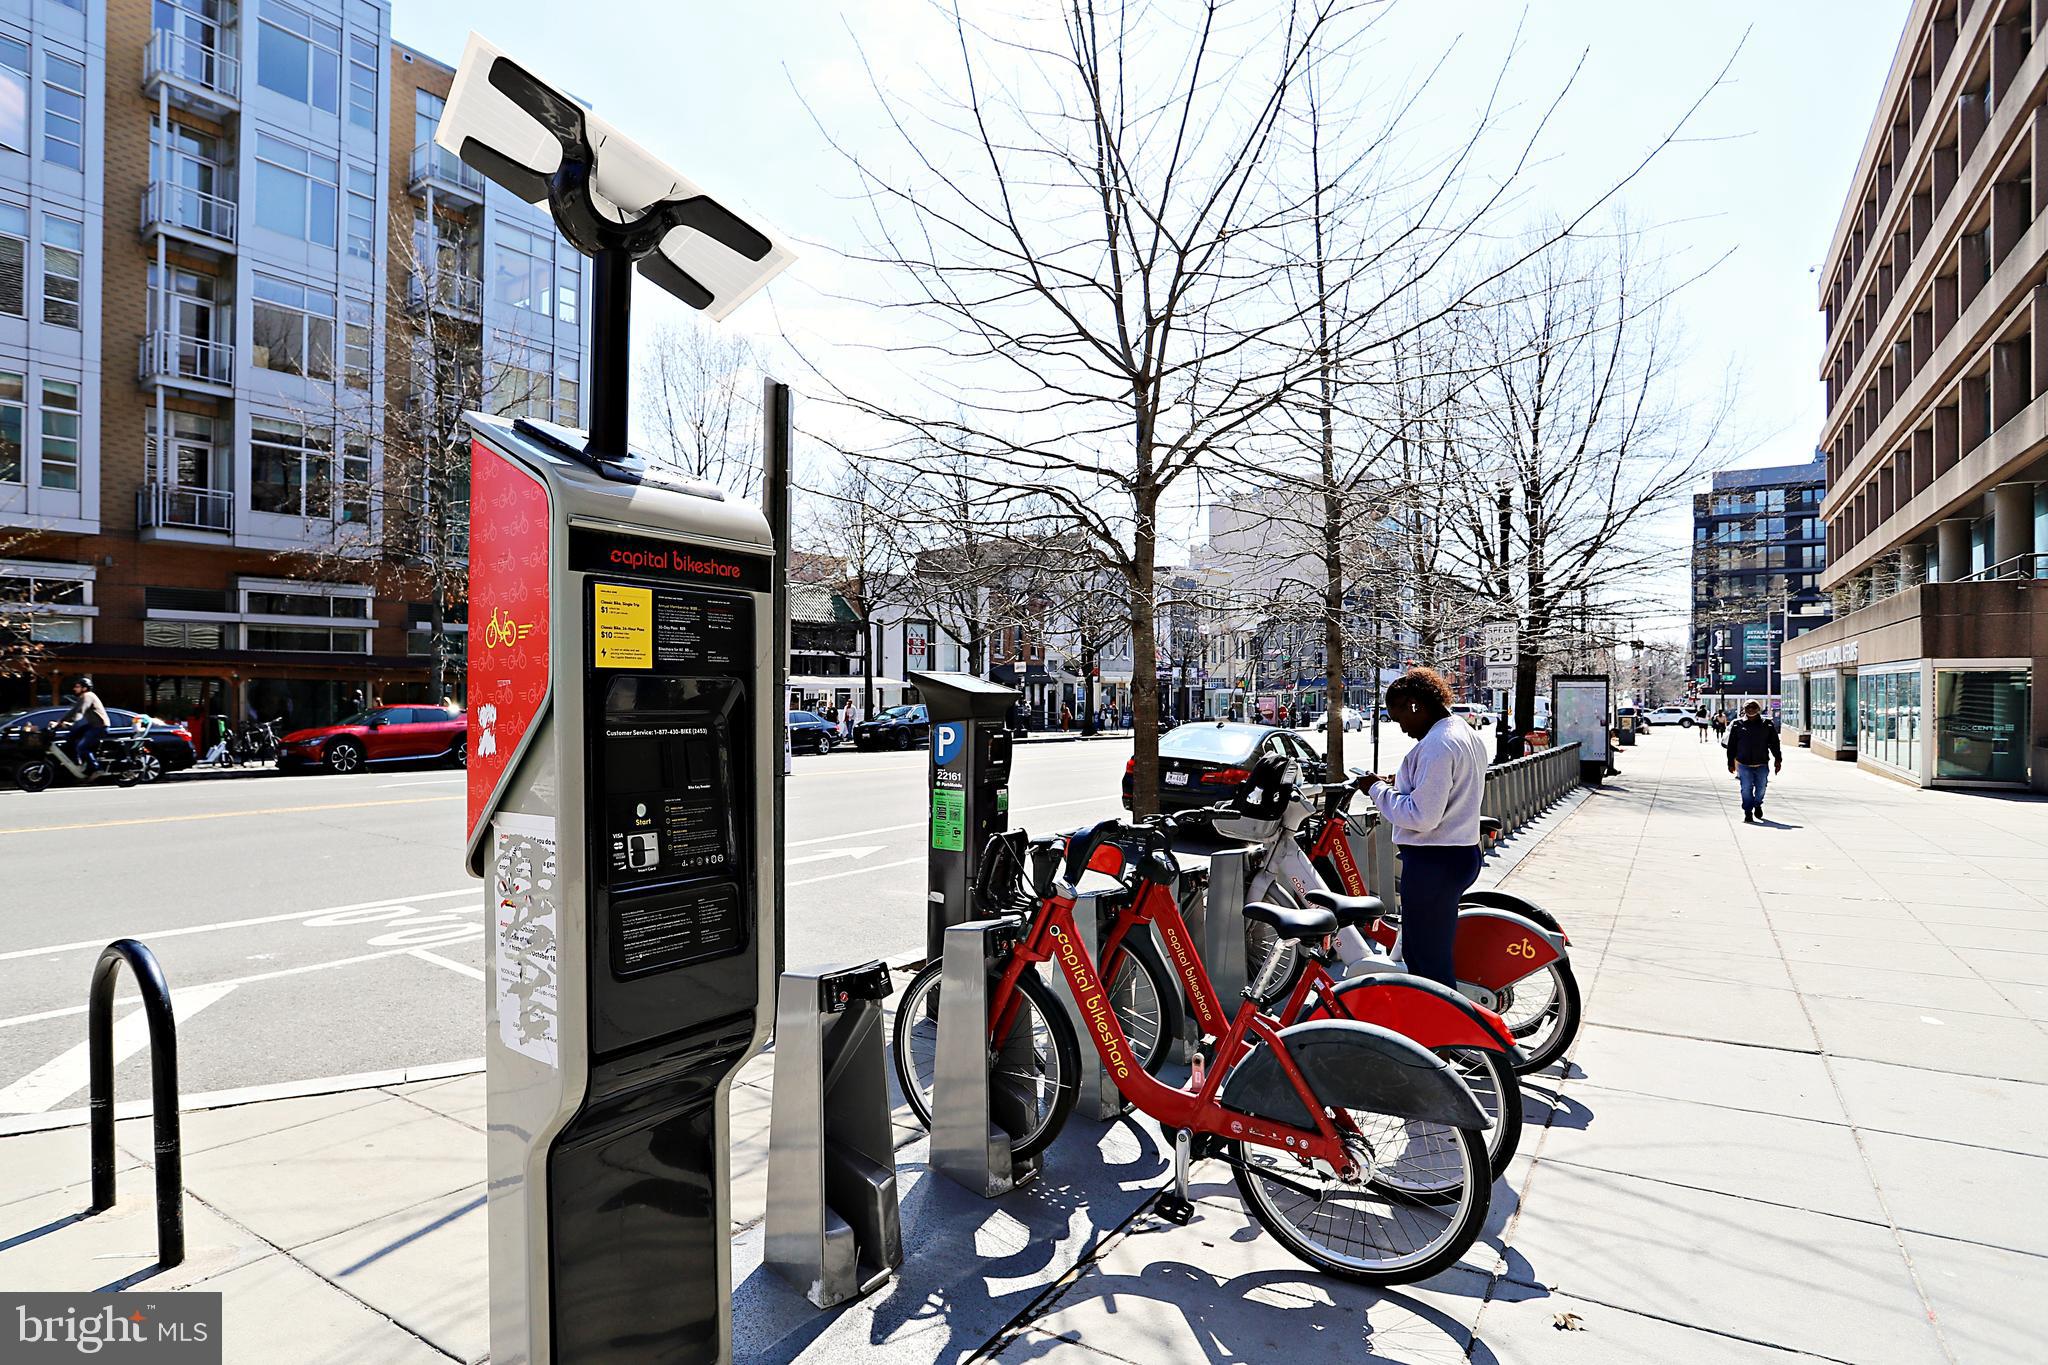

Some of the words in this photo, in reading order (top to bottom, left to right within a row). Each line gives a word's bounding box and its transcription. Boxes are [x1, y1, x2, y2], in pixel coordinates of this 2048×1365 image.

[610, 550, 668, 570] capital
[673, 550, 741, 578] bikeshare
[1490, 648, 1513, 662] 25
[938, 726, 956, 756] P
[937, 772, 961, 781] 22161
[1333, 838, 1354, 873] capital
[1167, 928, 1191, 967] capital
[1185, 967, 1212, 1021] bikeshare
[1058, 933, 1095, 992] capital
[1086, 994, 1129, 1079] bikeshare
